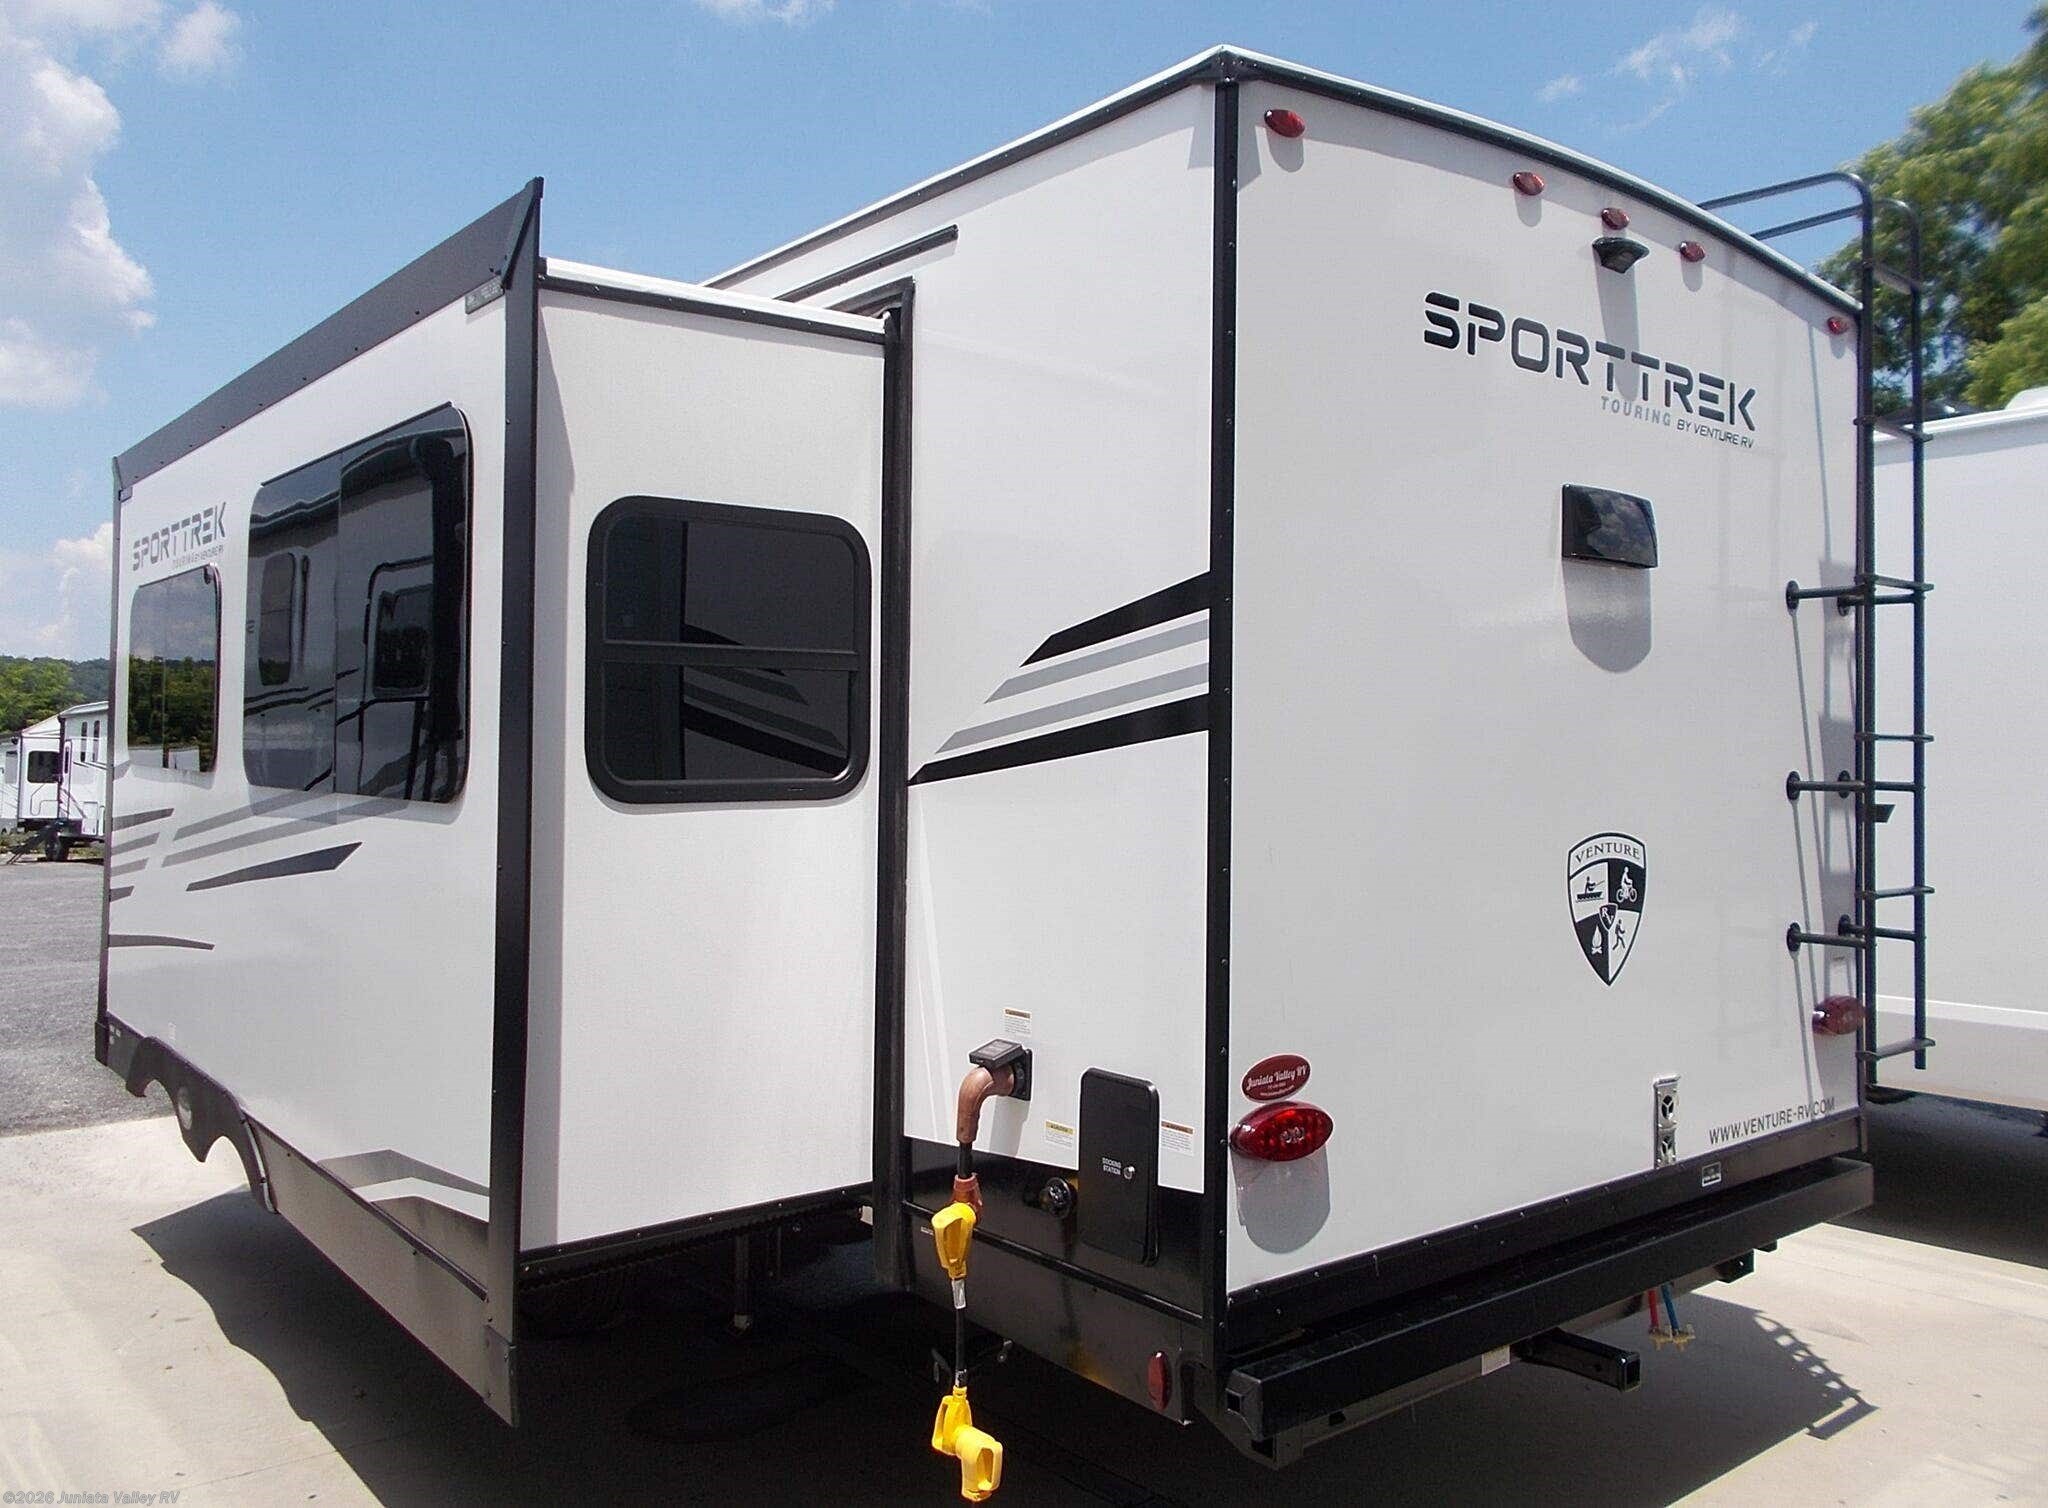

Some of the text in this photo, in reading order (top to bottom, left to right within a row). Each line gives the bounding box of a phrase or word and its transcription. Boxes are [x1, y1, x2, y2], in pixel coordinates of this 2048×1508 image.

[1424, 291, 1757, 432] SPORTTREK
[1601, 396, 1755, 448] TOURING BY VENTURE RV
[132, 502, 226, 571] SPORTTREK
[1575, 842, 1641, 864] VENTURE
[1246, 1076, 1274, 1091] Juniata
[1274, 1070, 1296, 1081] Valley
[1709, 1097, 1836, 1145] WWW.VENTURE-RV.COM
[1103, 1164, 1121, 1176] STATION
